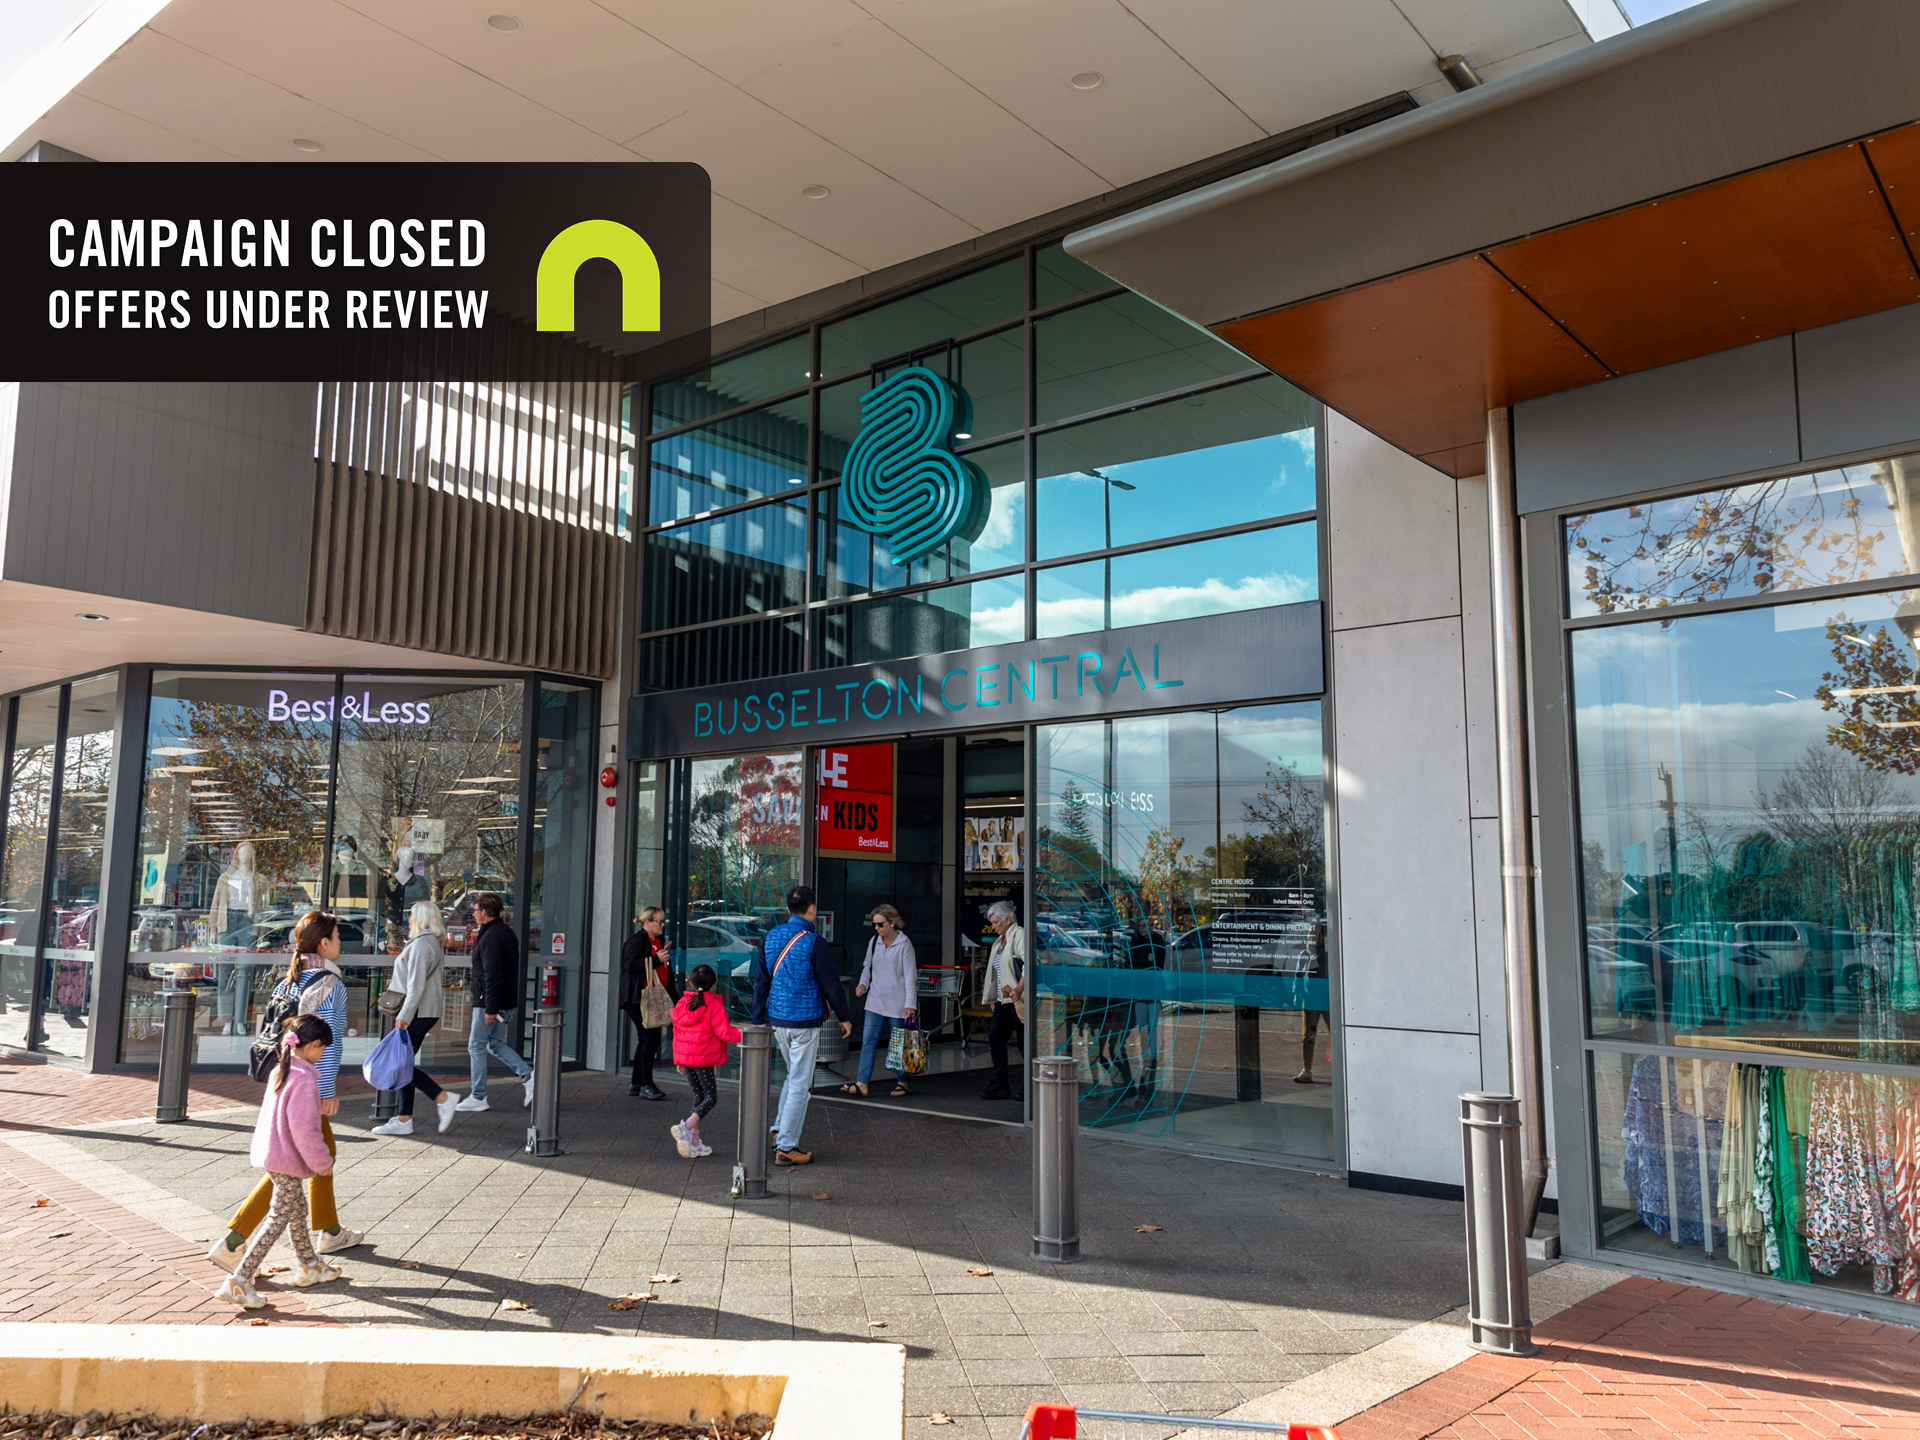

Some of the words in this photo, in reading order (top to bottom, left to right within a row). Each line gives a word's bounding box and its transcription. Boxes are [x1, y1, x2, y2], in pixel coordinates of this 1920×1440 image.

[694, 674, 922, 738] BUSSELTON
[940, 644, 1184, 712] CENTRAL
[268, 689, 431, 724] Best&Less
[834, 800, 878, 832] KIDS
[413, 831, 429, 839] BABY
[858, 836, 889, 848] Best&Less
[1212, 922, 1258, 930] ENTERTAINMENT
[1265, 923, 1285, 931] DINING
[1286, 924, 1316, 932] PRECINCT
